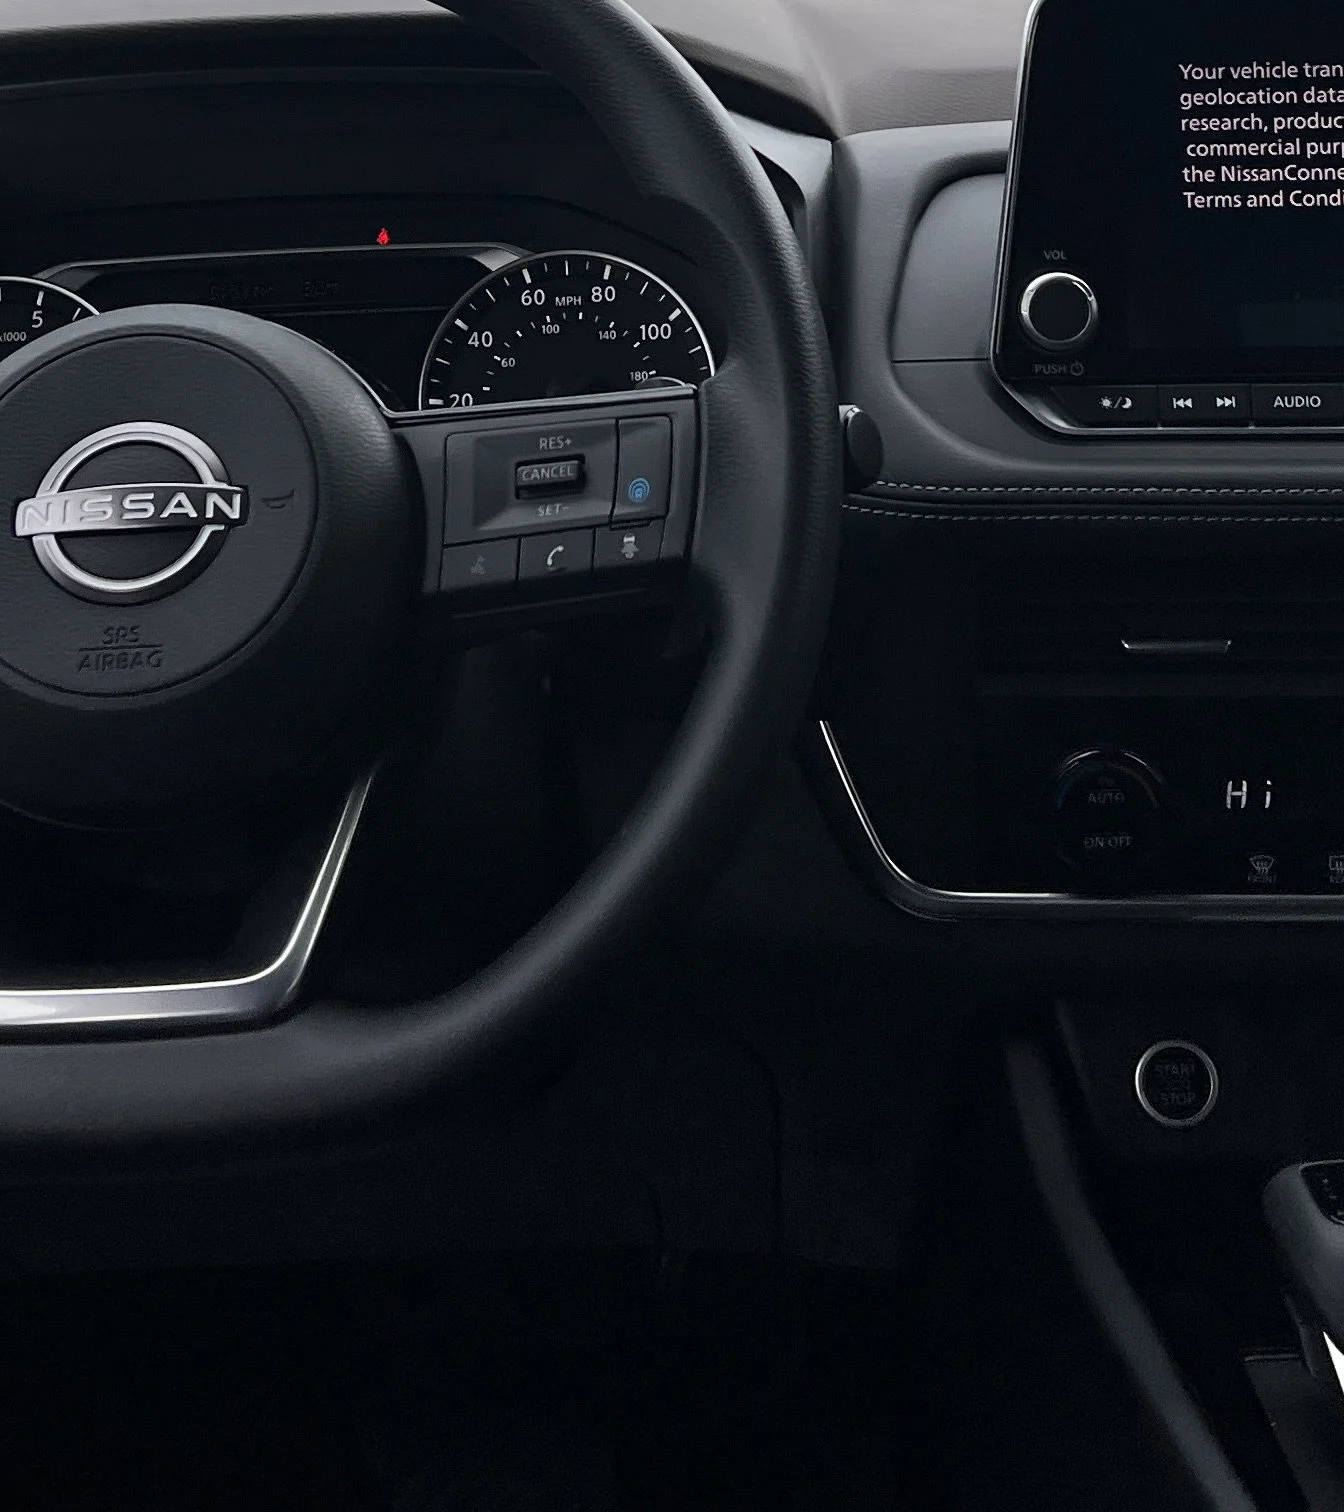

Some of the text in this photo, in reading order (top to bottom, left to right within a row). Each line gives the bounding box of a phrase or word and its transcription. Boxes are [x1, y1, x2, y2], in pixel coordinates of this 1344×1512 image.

[1178, 63, 1226, 80] Your
[1229, 60, 1299, 79] vehicle
[1179, 87, 1298, 111] geolocation
[1181, 112, 1268, 133] research,
[1186, 137, 1301, 157] commercial
[1181, 164, 1216, 183] the
[1182, 191, 1242, 209] Terms
[1246, 189, 1284, 208] and
[1043, 248, 1069, 261] VOL
[520, 288, 546, 307] 60
[555, 294, 582, 308] MPH
[591, 285, 616, 304] 80
[31, 309, 44, 329] 5
[540, 323, 561, 336] 100
[598, 328, 618, 341] 140
[639, 322, 673, 342] 100
[467, 330, 493, 349] 40
[500, 356, 516, 369] 60
[1034, 363, 1067, 376] PUSH
[629, 369, 649, 383] 180
[449, 392, 474, 408] 20
[1272, 394, 1322, 409] AUDIO
[520, 463, 576, 482] CANCEL
[21, 491, 242, 532] NISSAN
[77, 650, 163, 673] AIRBAG
